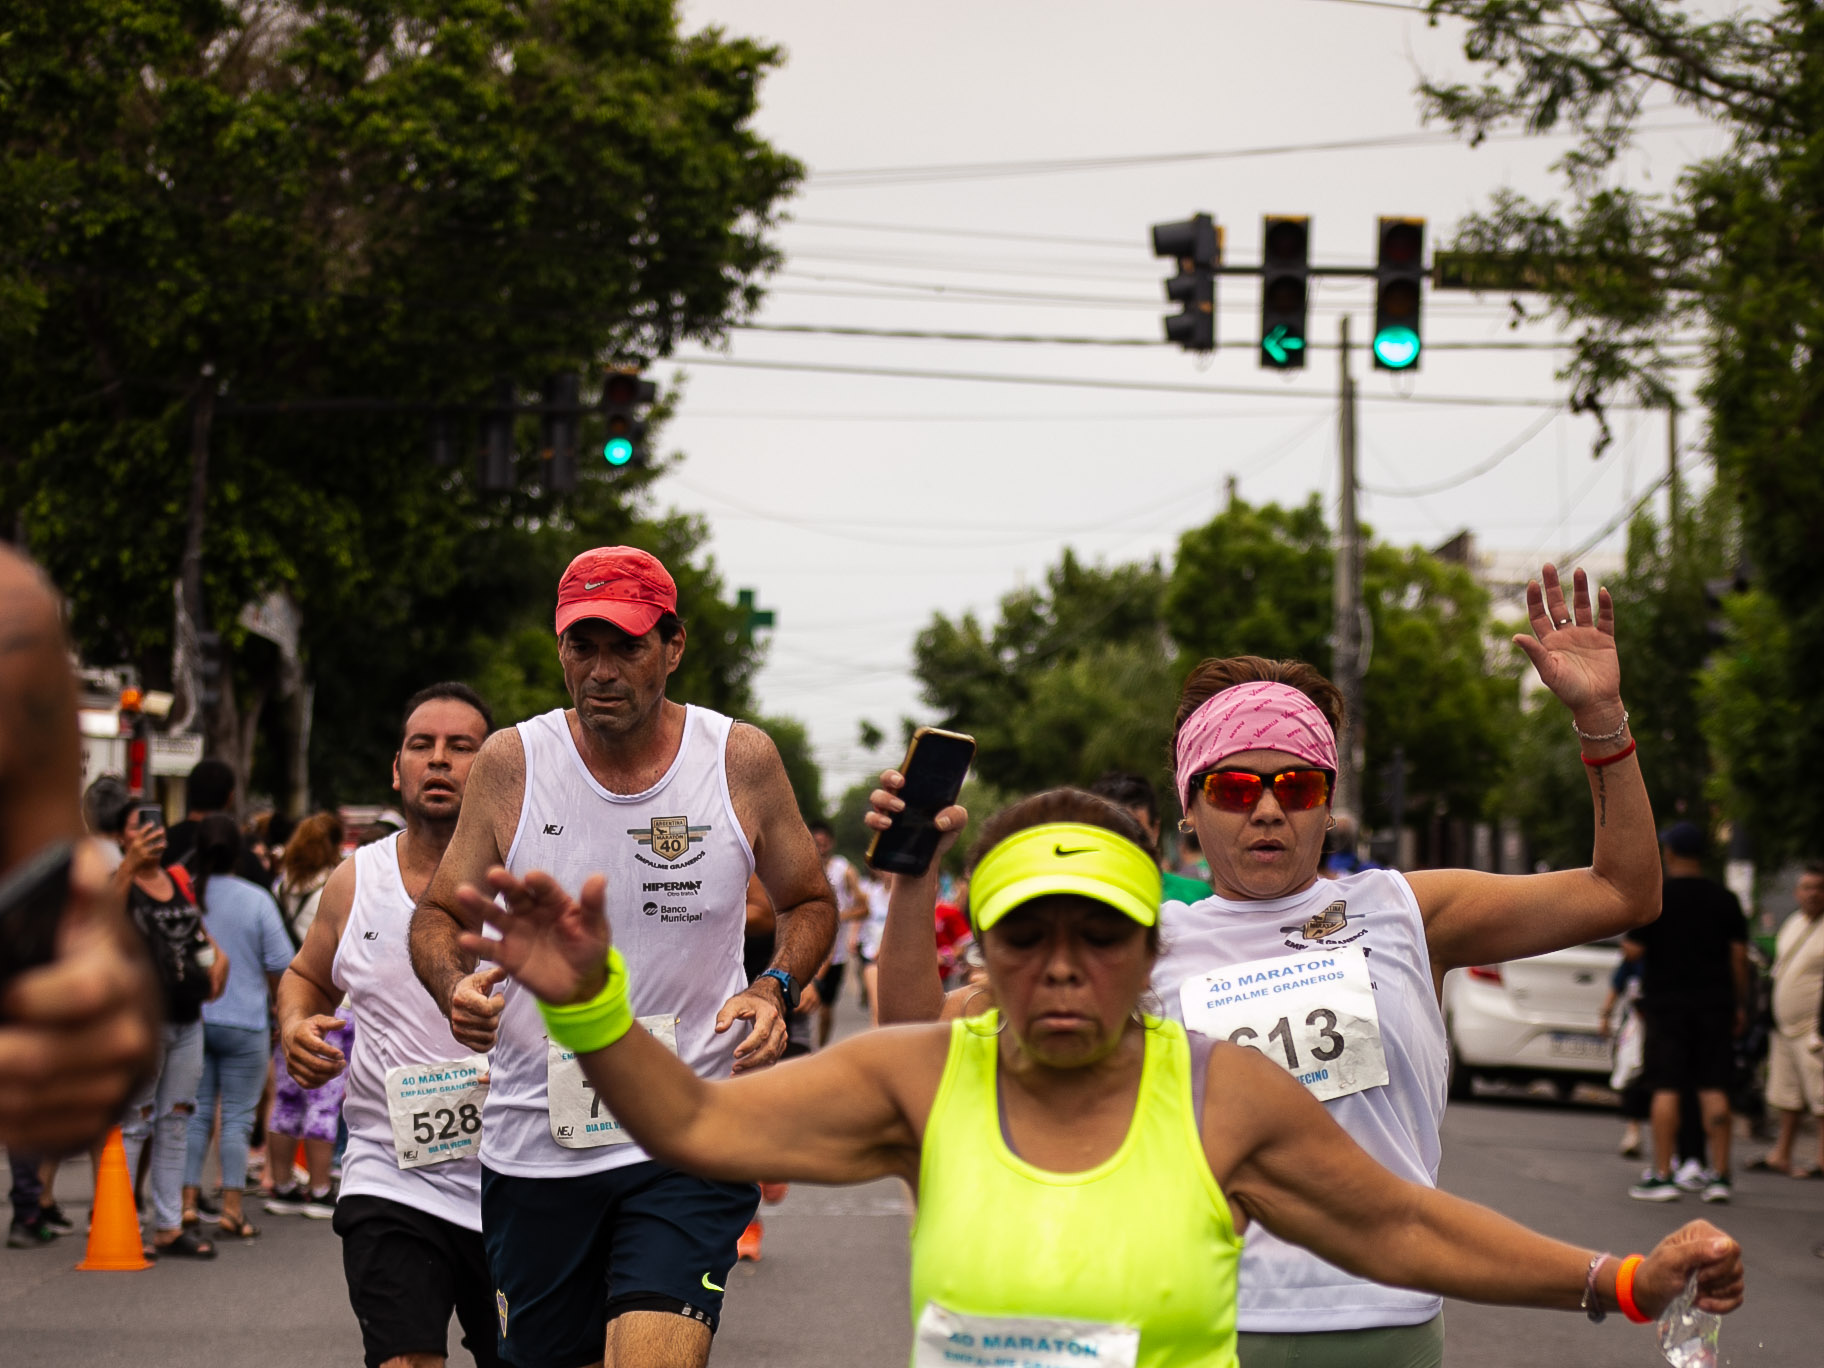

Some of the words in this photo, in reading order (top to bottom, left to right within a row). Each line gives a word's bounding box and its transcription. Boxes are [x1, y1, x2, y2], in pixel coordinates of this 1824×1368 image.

[543, 824, 563, 835] NEJ
[660, 840, 681, 853] 40
[634, 853, 669, 870] EMPALME
[669, 850, 706, 870] GRANEROS
[661, 905, 687, 914] Banco
[661, 912, 702, 923] Municipal
[363, 930, 379, 941] NEJ
[1209, 981, 1232, 993] 40
[1238, 958, 1336, 987] MARATON
[1207, 988, 1270, 1009] EMPALME
[1273, 970, 1345, 994] GRANEROS
[402, 1076, 416, 1086] 40
[418, 1068, 477, 1084] MARATON
[1297, 1068, 1329, 1085] ECINO
[400, 1087, 437, 1098] EMPALME
[440, 1081, 478, 1093] GRANERO
[413, 1103, 483, 1145] 528
[557, 1126, 574, 1137] NEJ
[585, 1123, 599, 1133] DIA
[600, 1122, 613, 1132] DEL
[983, 1335, 1099, 1358] MARATON
